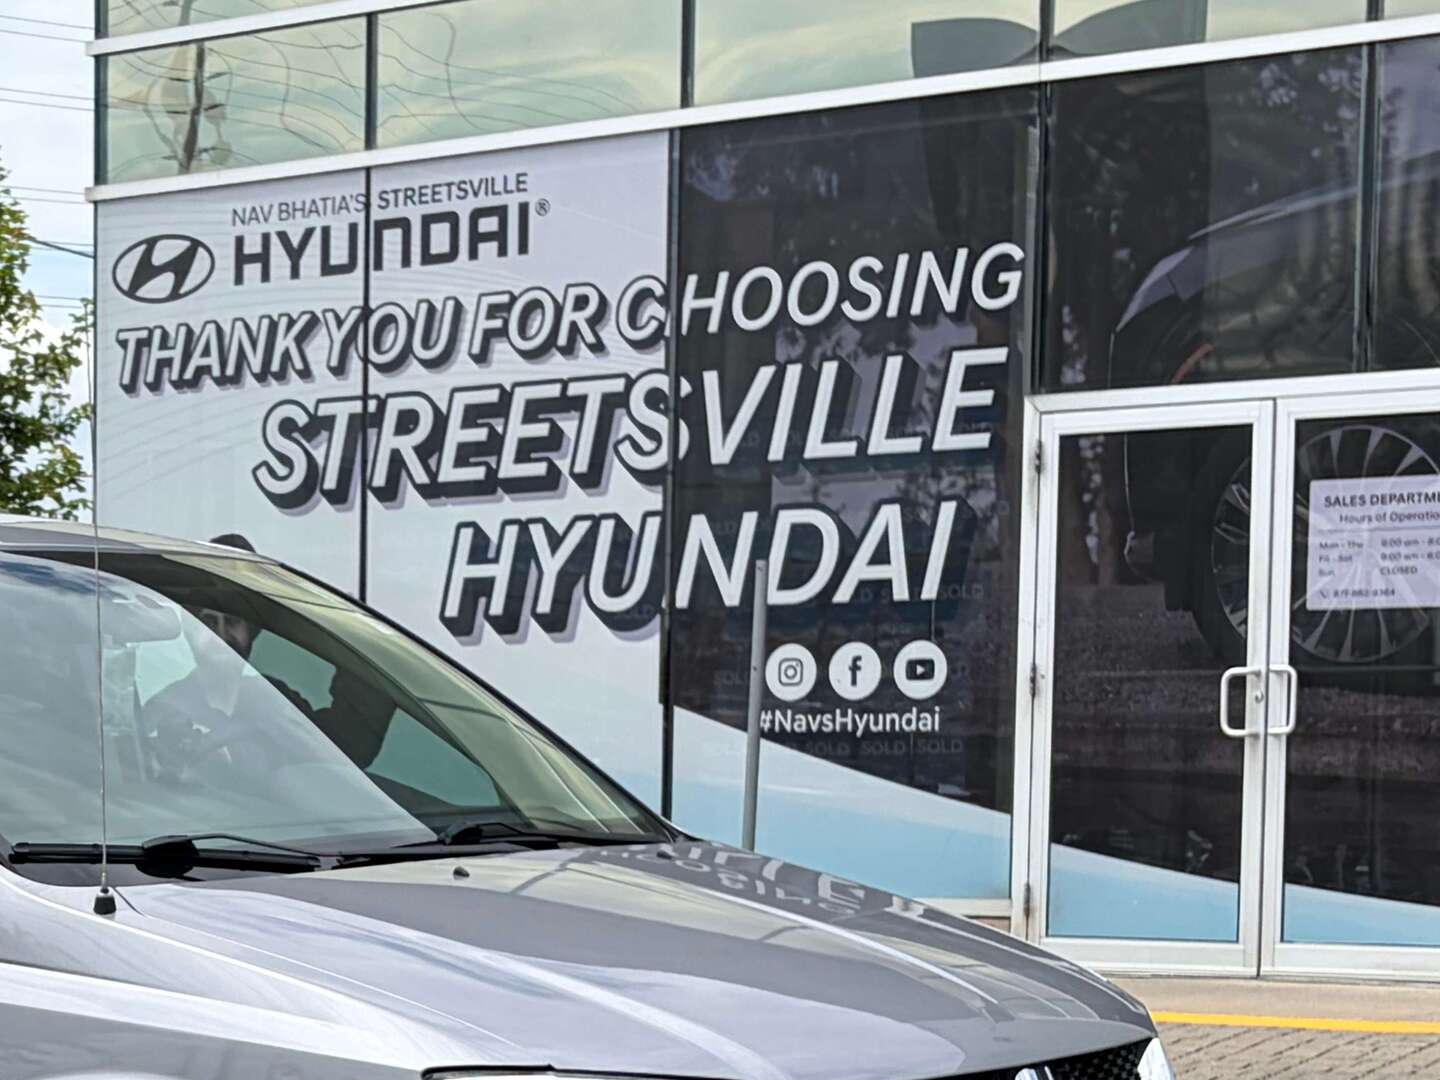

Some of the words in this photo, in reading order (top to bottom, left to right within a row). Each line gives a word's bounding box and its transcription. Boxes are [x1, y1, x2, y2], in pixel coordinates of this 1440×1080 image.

[232, 203, 273, 227] NAV
[278, 193, 367, 222] BHATIA'S
[378, 172, 529, 210] STREETSVILLE
[115, 309, 317, 394] THANK
[321, 296, 465, 376] YOU
[469, 281, 606, 366] FOR
[615, 242, 1025, 346] CHOOSING
[252, 346, 1010, 514] STREETSVILLE
[1324, 494, 1366, 509] SALES
[1339, 513, 1372, 525] Hours
[1375, 512, 1387, 523] of
[439, 500, 962, 643] HYUNDAI
[1379, 564, 1418, 575] CLOSED
[759, 706, 940, 736] #NavsHyundai
